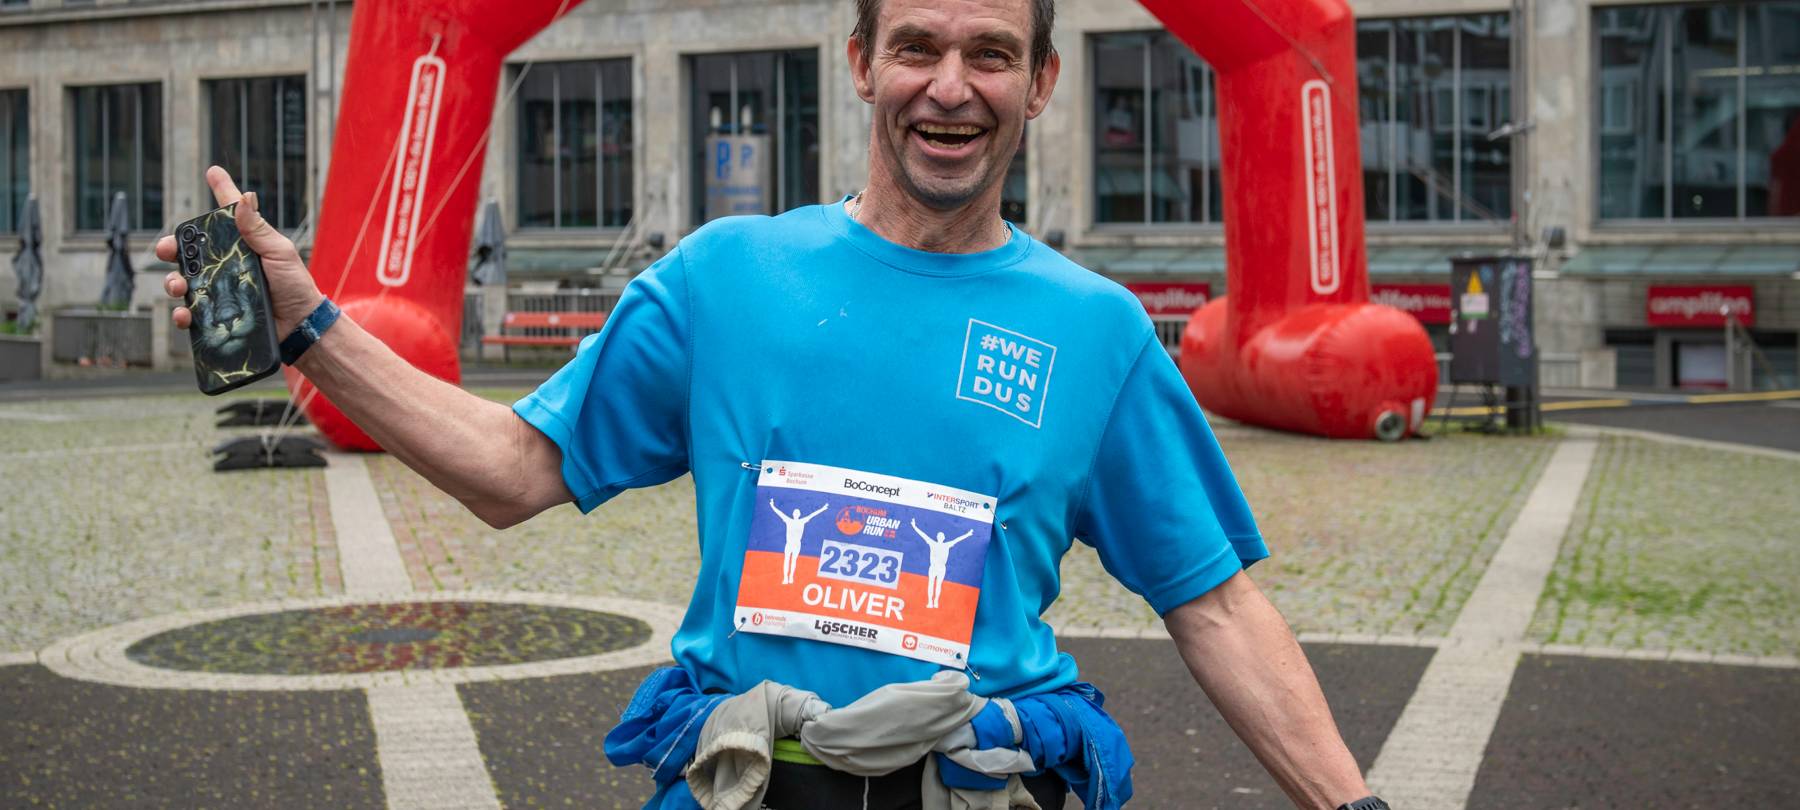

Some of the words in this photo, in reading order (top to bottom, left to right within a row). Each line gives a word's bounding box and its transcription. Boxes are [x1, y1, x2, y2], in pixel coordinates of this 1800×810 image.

[1138, 287, 1207, 312] mplifon
[1650, 290, 1750, 319] amplifon
[980, 333, 1042, 369] #WE
[977, 354, 1037, 391] RUN
[973, 375, 1032, 413] DUS
[843, 478, 901, 498] BoConcept
[933, 493, 979, 509] INTERSPORT
[943, 502, 967, 514] BALTZ
[863, 525, 884, 537] RUN
[866, 515, 900, 530] URBAN
[820, 545, 900, 584] 2323
[802, 583, 905, 621] OLIVER
[814, 619, 879, 640] LÖSCHER
